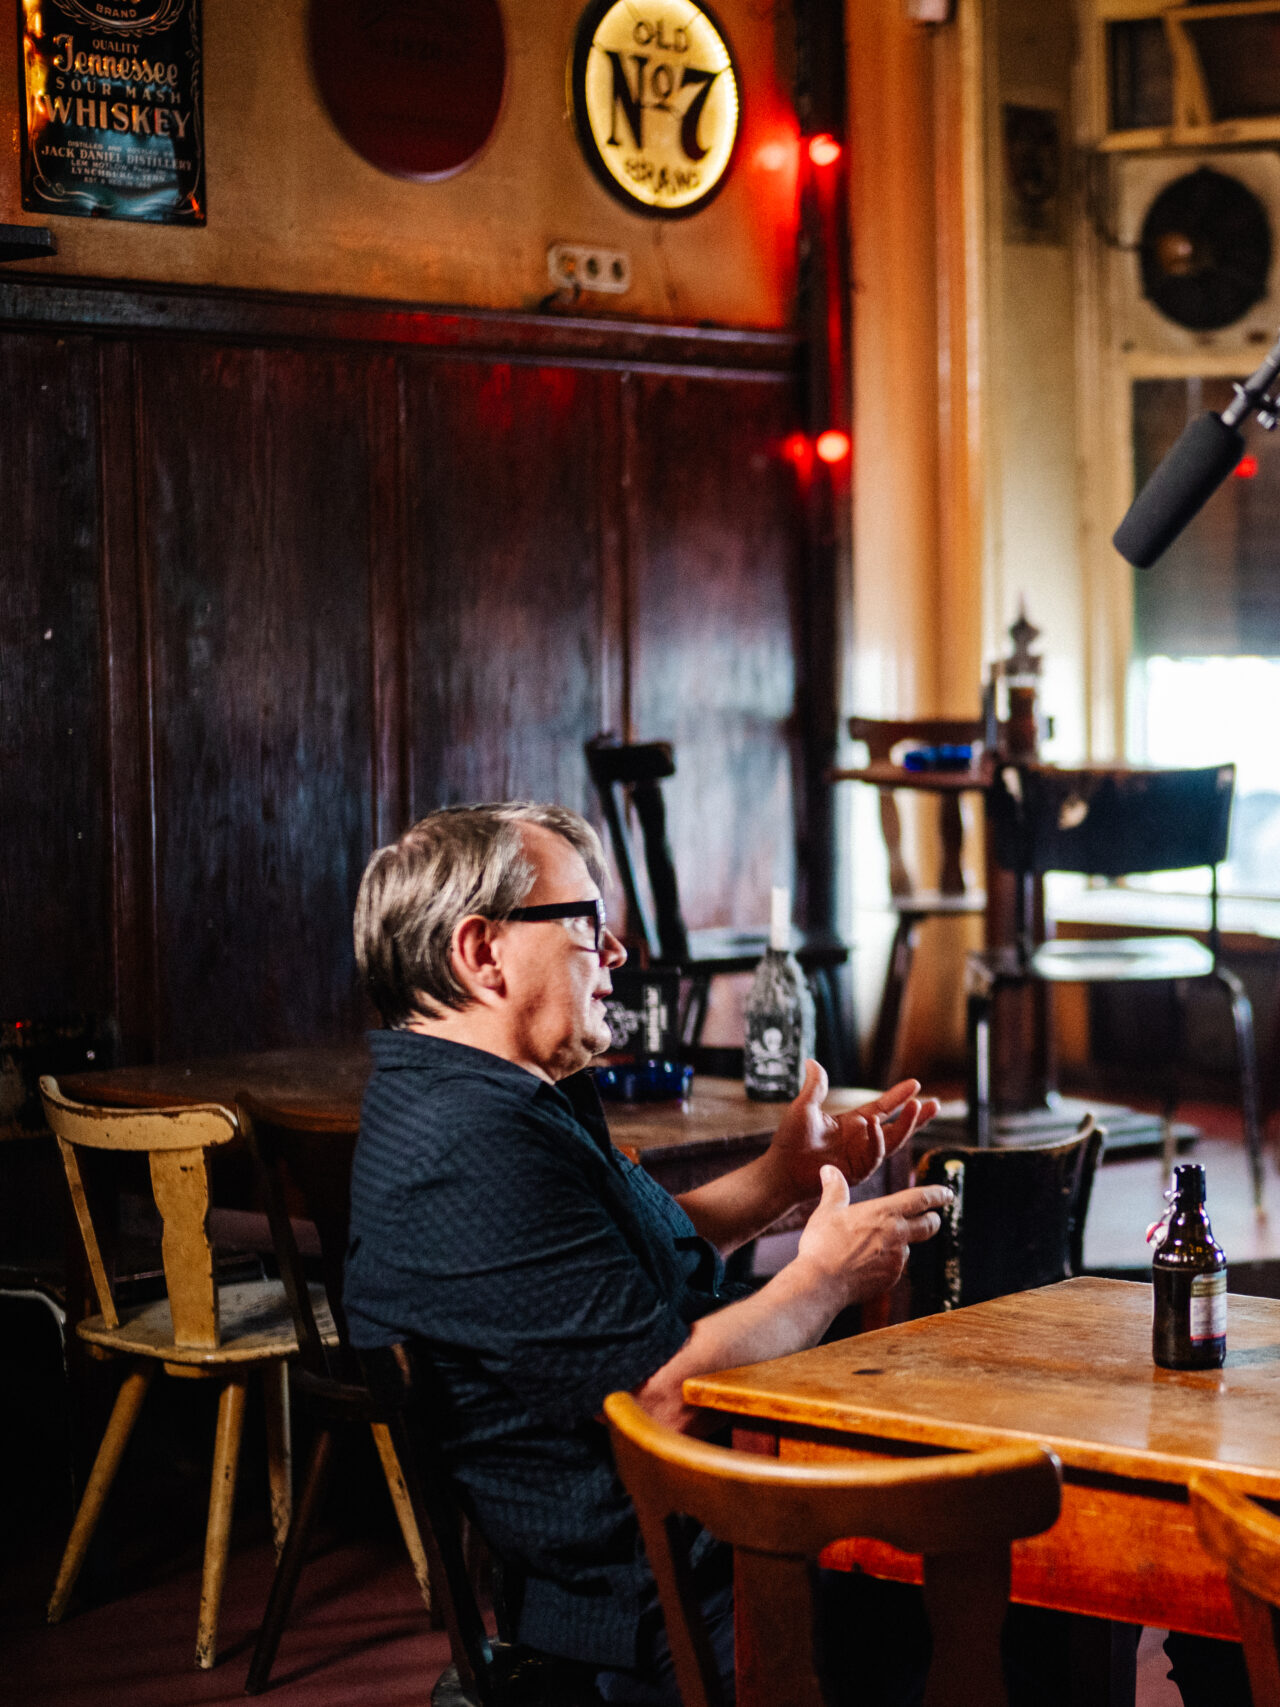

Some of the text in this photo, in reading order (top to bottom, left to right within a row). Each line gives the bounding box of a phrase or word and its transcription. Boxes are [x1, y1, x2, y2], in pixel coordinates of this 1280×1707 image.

[95, 3, 138, 18] BRAND
[92, 38, 140, 54] QUALITY
[633, 19, 689, 52] OLD
[52, 33, 179, 86] Tennessee
[56, 77, 182, 104] SOUR MASH
[45, 94, 191, 139] WHISKEY
[41, 145, 76, 158] JACK
[80, 150, 122, 164] DANIEL
[127, 154, 192, 172] DISTILLERY
